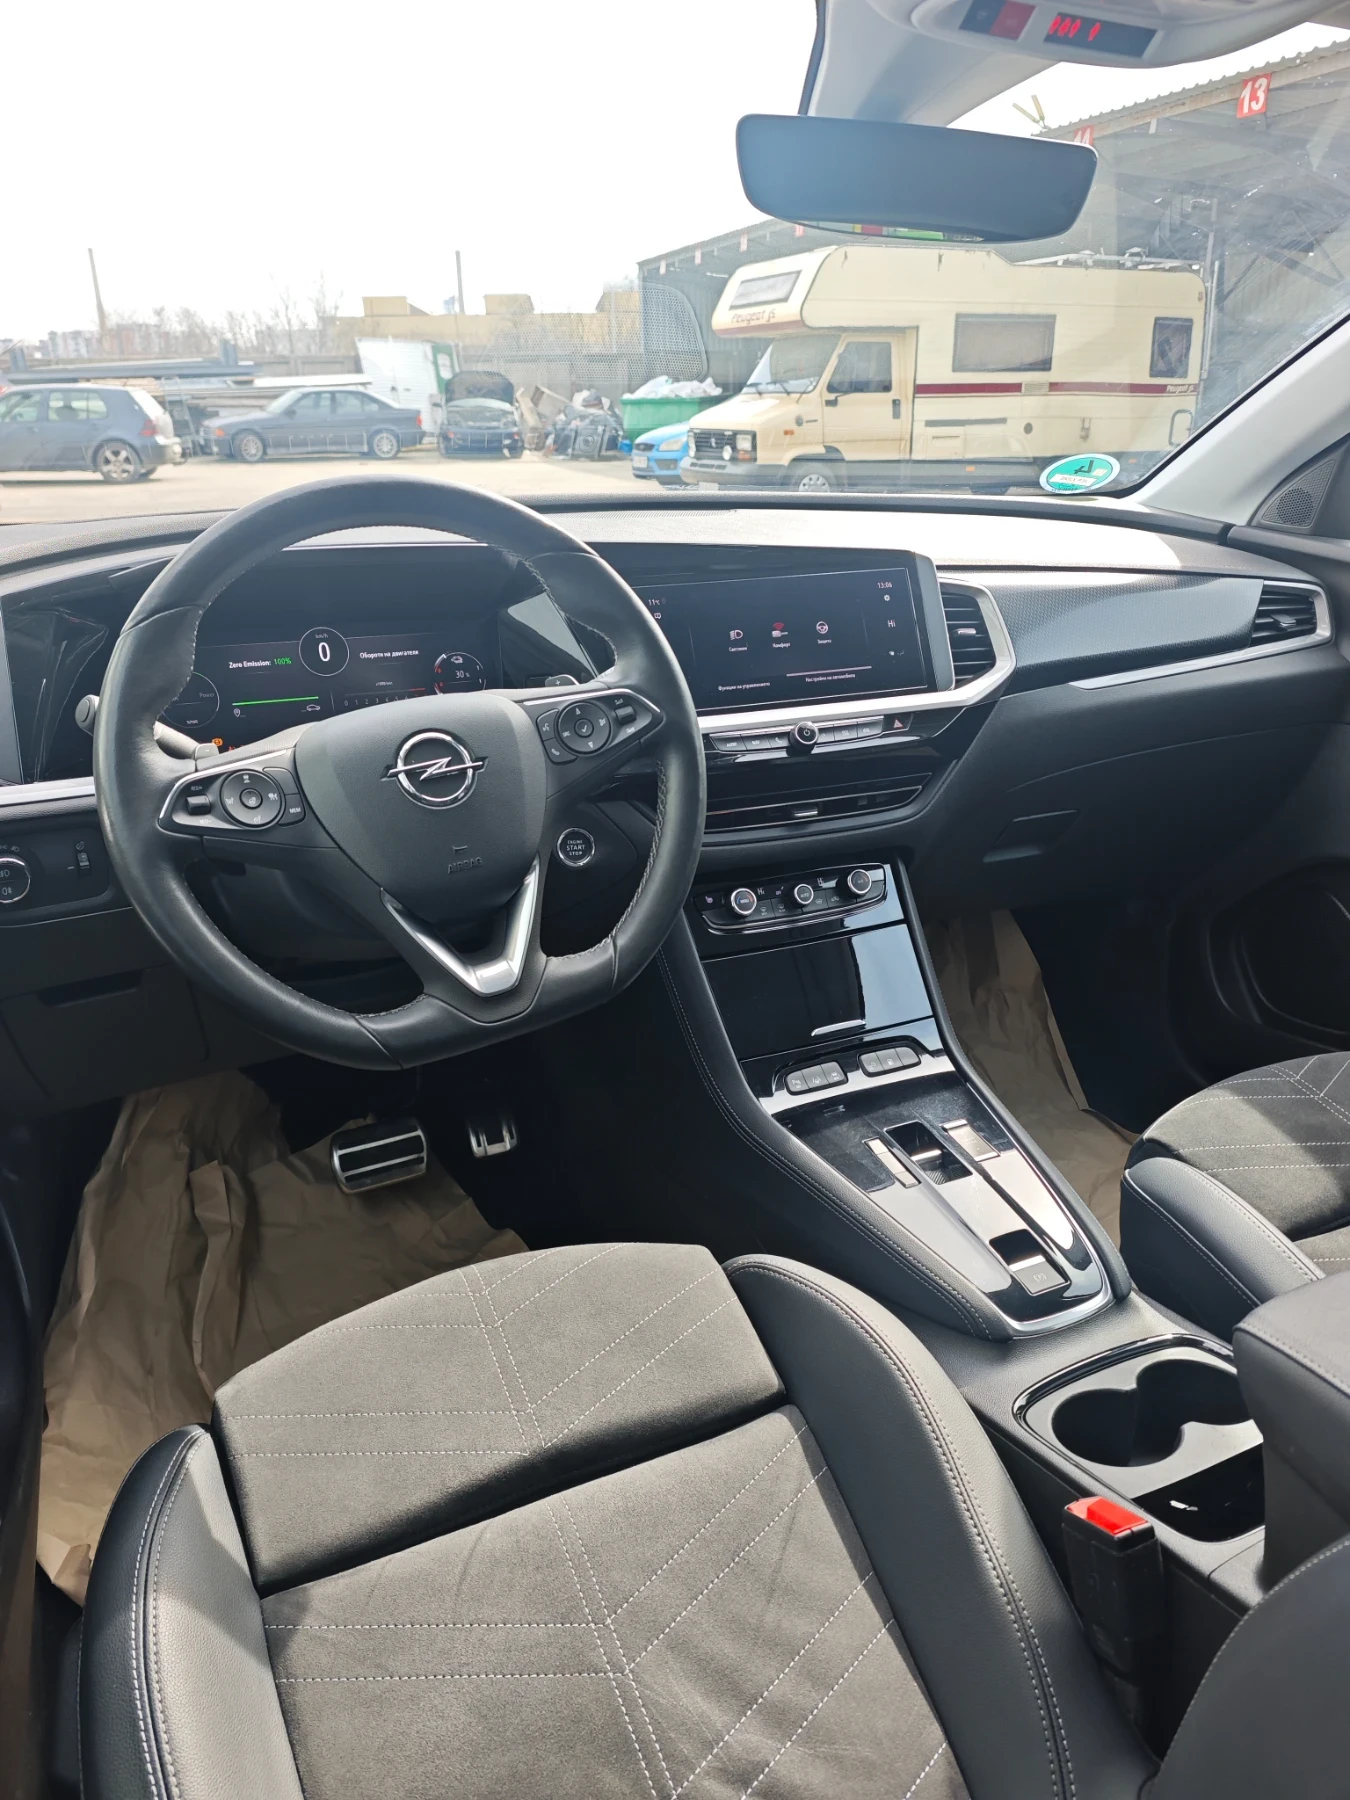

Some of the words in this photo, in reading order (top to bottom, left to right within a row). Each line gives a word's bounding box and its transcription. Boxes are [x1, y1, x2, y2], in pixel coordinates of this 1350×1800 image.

[1239, 77, 1269, 114] 13
[318, 641, 331, 662] 0
[229, 661, 243, 669] Zero
[243, 660, 272, 668] Emission:
[273, 657, 292, 666] 100%
[455, 670, 465, 679] 30
[447, 856, 483, 874] AIRBAG
